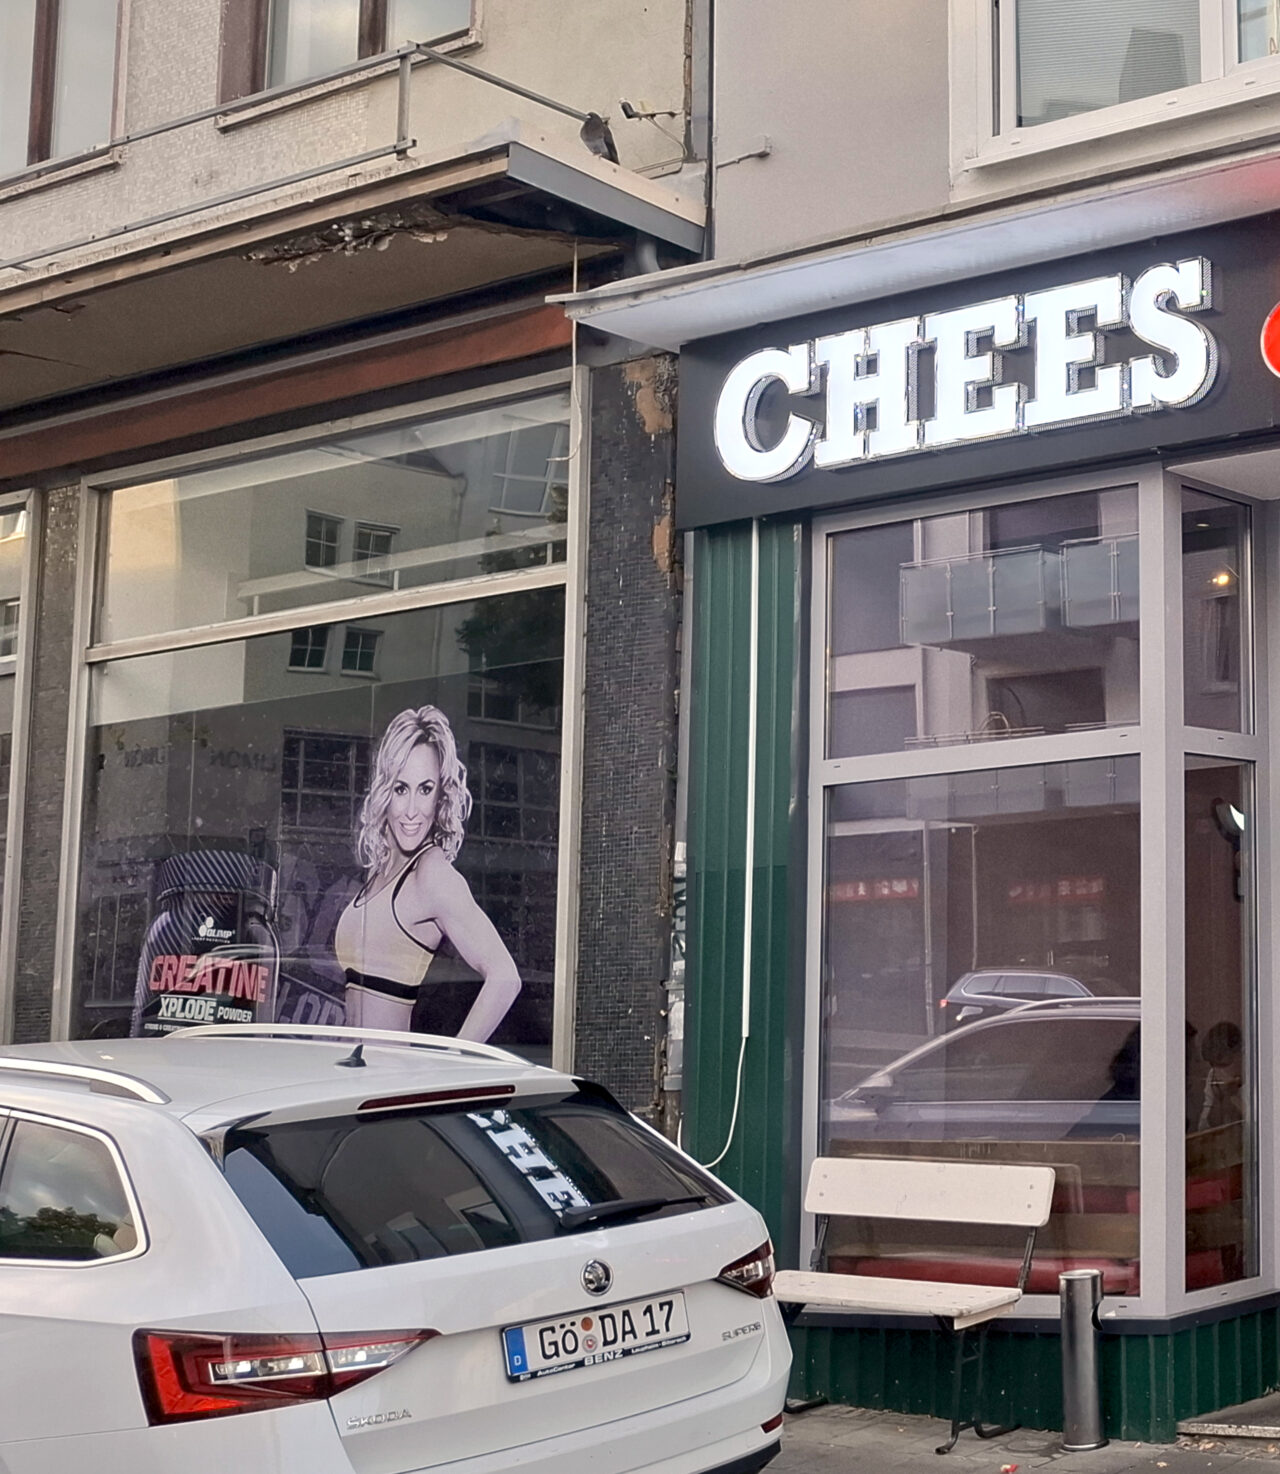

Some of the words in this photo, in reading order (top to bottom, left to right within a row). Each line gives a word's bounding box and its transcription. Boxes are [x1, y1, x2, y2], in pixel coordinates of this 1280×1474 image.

[714, 256, 1218, 483] CHEES
[150, 955, 270, 1003] CREATINE
[158, 996, 217, 1022] XPLODE
[217, 1006, 253, 1023] POWDER
[513, 1354, 522, 1367] D
[538, 1321, 580, 1361] GÖ
[599, 1309, 638, 1347] DA
[642, 1299, 675, 1337] 17
[584, 1348, 625, 1367] BENZ
